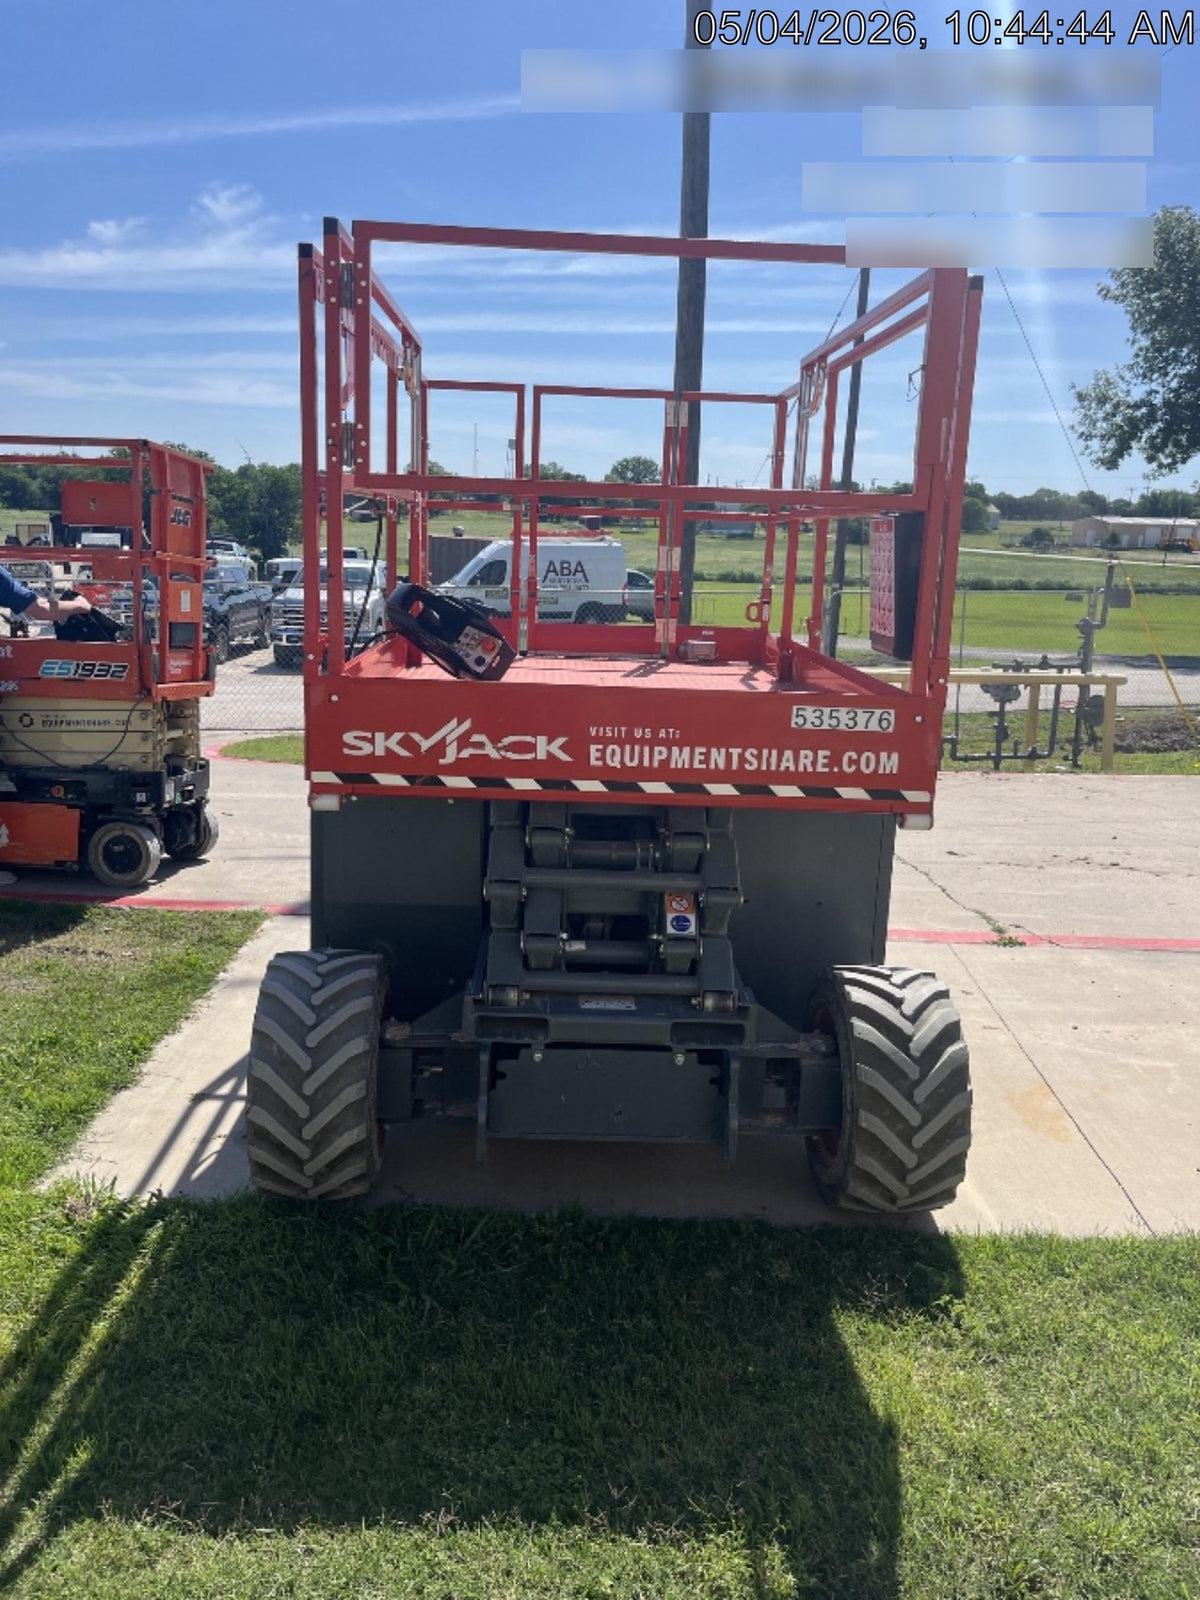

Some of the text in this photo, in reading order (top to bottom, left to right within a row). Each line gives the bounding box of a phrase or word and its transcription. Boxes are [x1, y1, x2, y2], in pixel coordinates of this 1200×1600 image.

[541, 560, 589, 584] ABA
[794, 707, 892, 731] 535376
[342, 717, 574, 765] SKYJACK
[589, 726, 680, 740] VISIT US AT:
[589, 743, 899, 775] EQUIPMENTSHARE.COM
